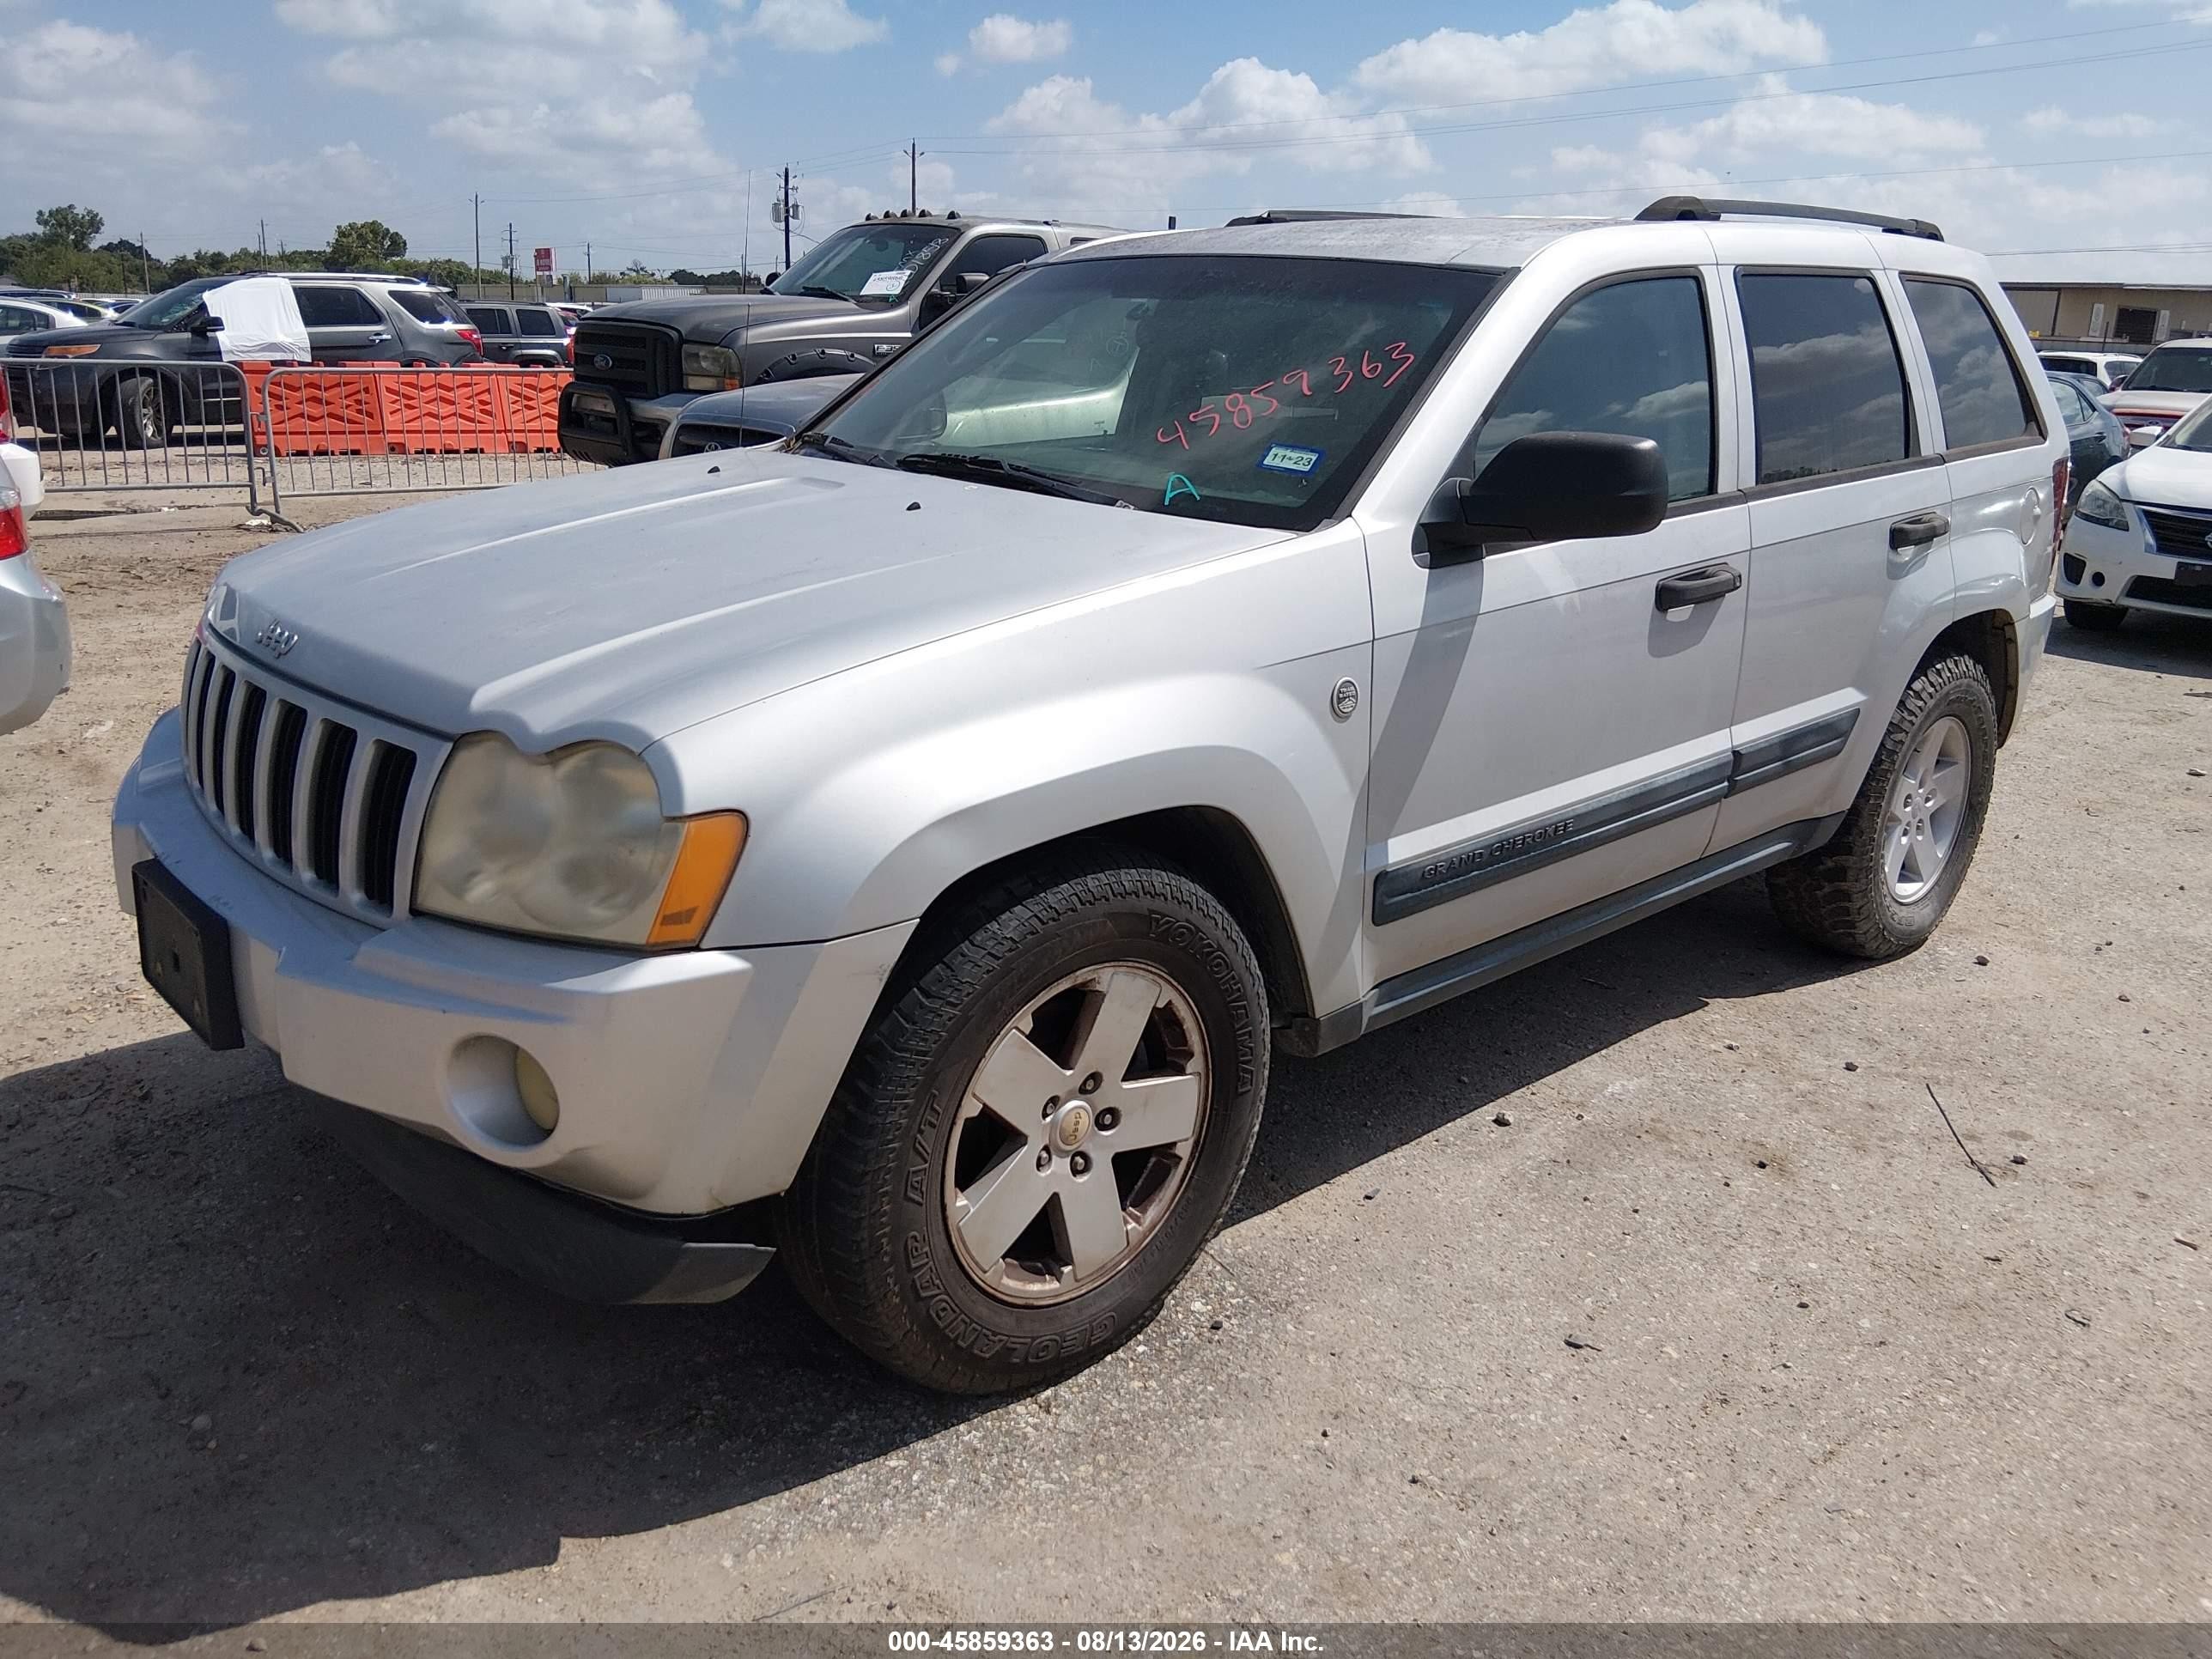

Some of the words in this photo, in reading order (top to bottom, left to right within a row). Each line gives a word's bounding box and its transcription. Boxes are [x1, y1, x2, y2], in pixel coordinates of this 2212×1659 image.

[1157, 342, 1415, 450] 45859363
[1164, 474, 1200, 507] A
[1422, 848, 1485, 880] GRAND
[1490, 817, 1575, 857] CHEROKEE
[1146, 909, 1255, 1095] YOKOHAMA
[905, 1229, 1117, 1364] GEOLANDAR
